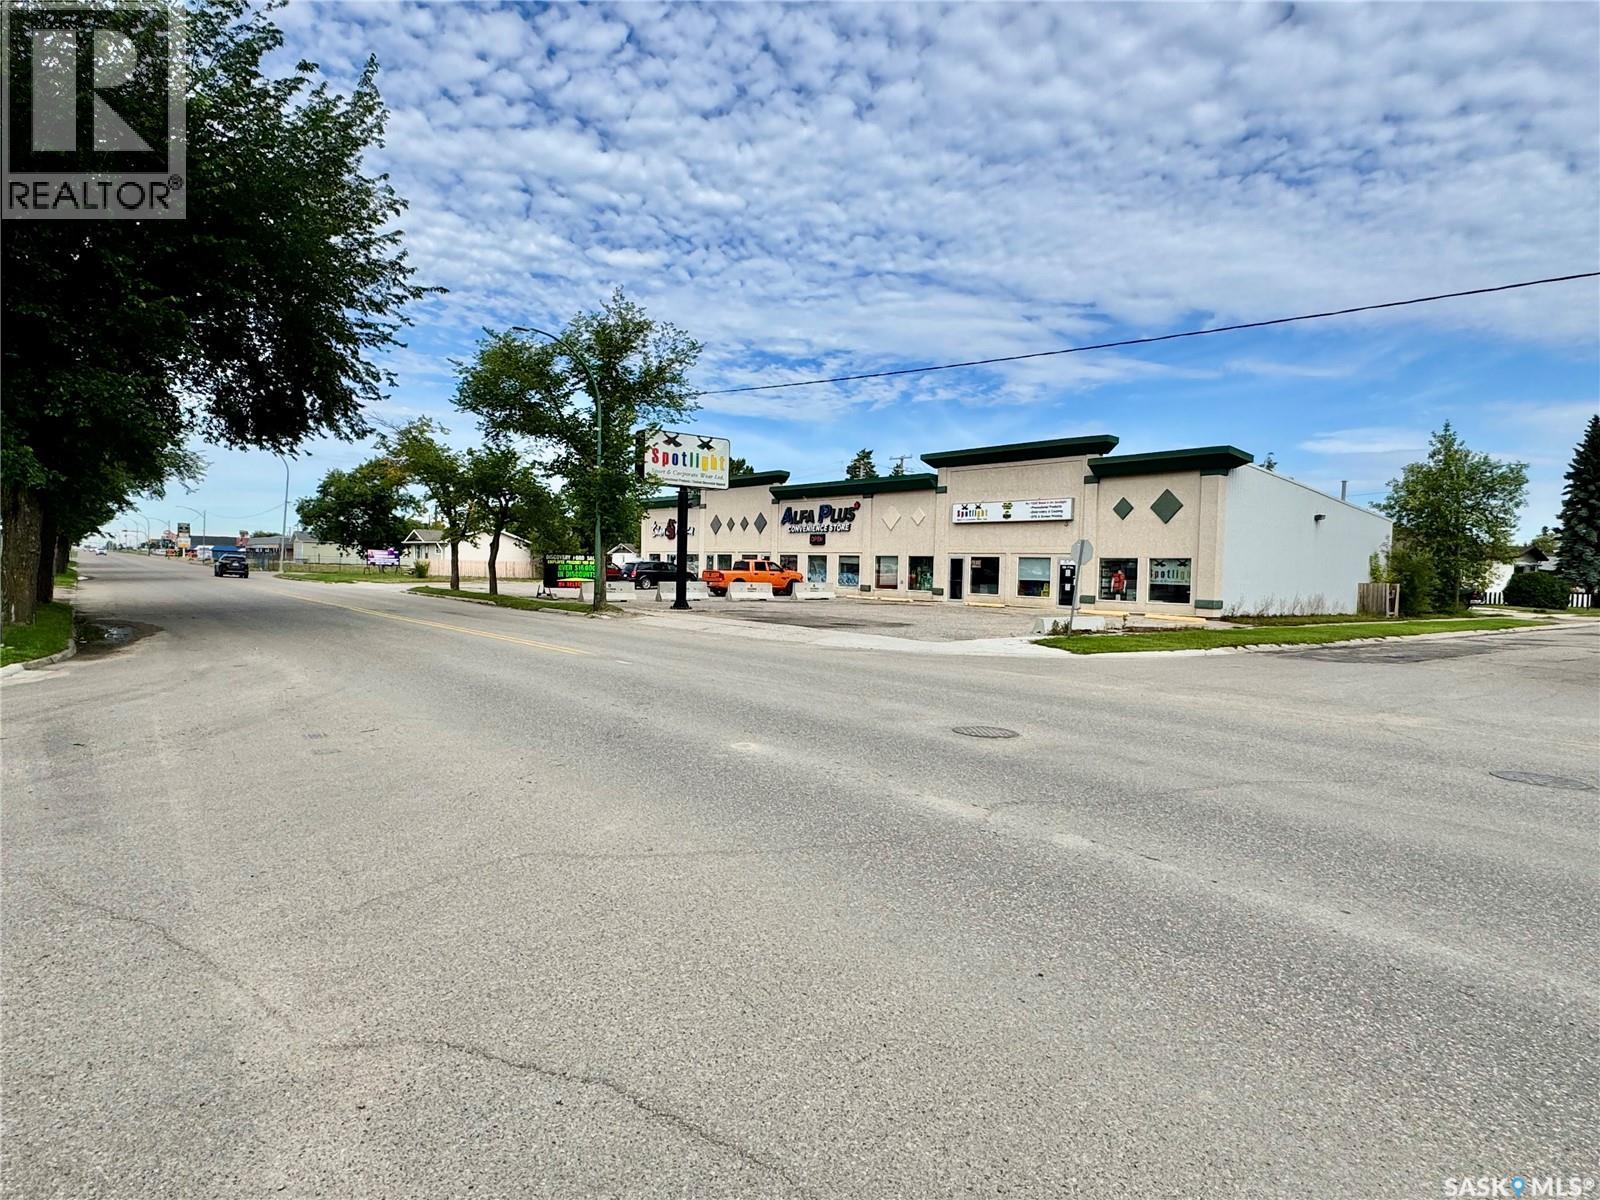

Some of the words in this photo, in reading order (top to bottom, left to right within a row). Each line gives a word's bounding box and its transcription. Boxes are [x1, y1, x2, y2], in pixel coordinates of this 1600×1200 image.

[651, 447, 726, 472] Spotlight
[781, 507, 816, 526] ALFA
[818, 504, 857, 524] PLUS
[788, 524, 828, 533] CONVENIENCE
[829, 523, 852, 533] STORE
